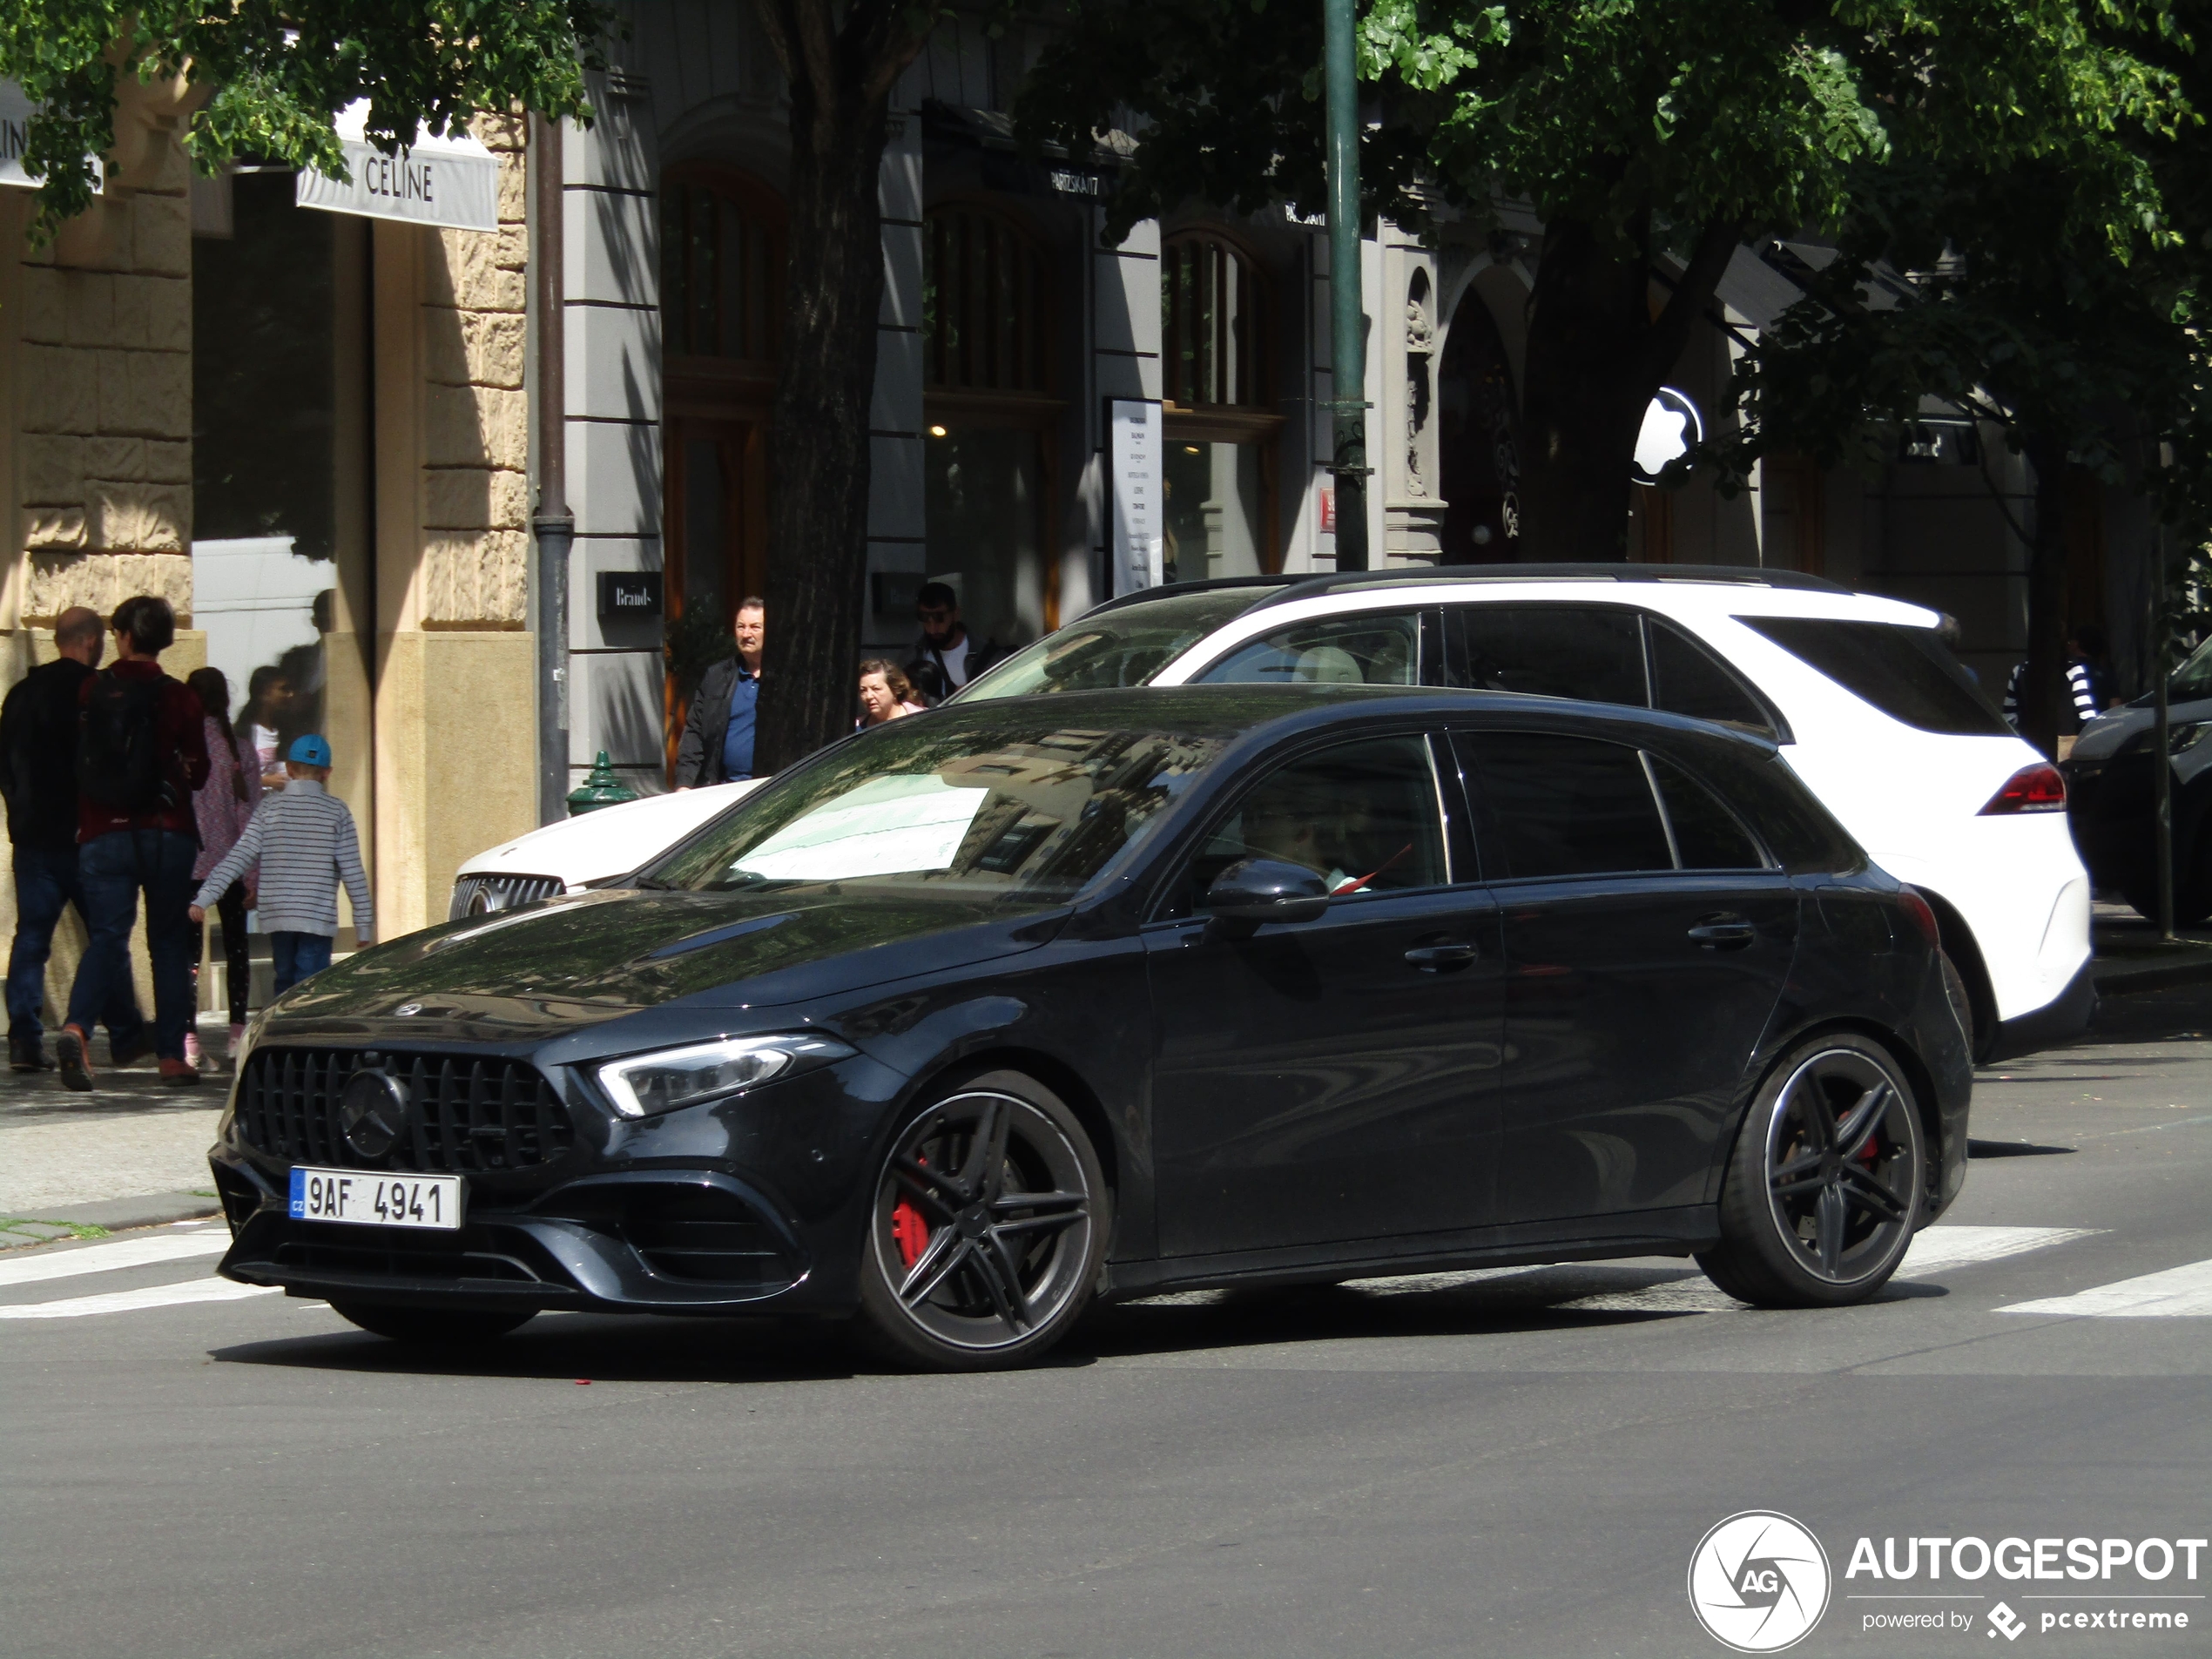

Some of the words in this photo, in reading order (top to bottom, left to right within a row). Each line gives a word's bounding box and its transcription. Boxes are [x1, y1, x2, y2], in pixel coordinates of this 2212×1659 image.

[366, 157, 433, 202] CELINE
[292, 1200, 304, 1212] CZ
[309, 1177, 352, 1217] 9AF
[374, 1181, 441, 1222] 4941
